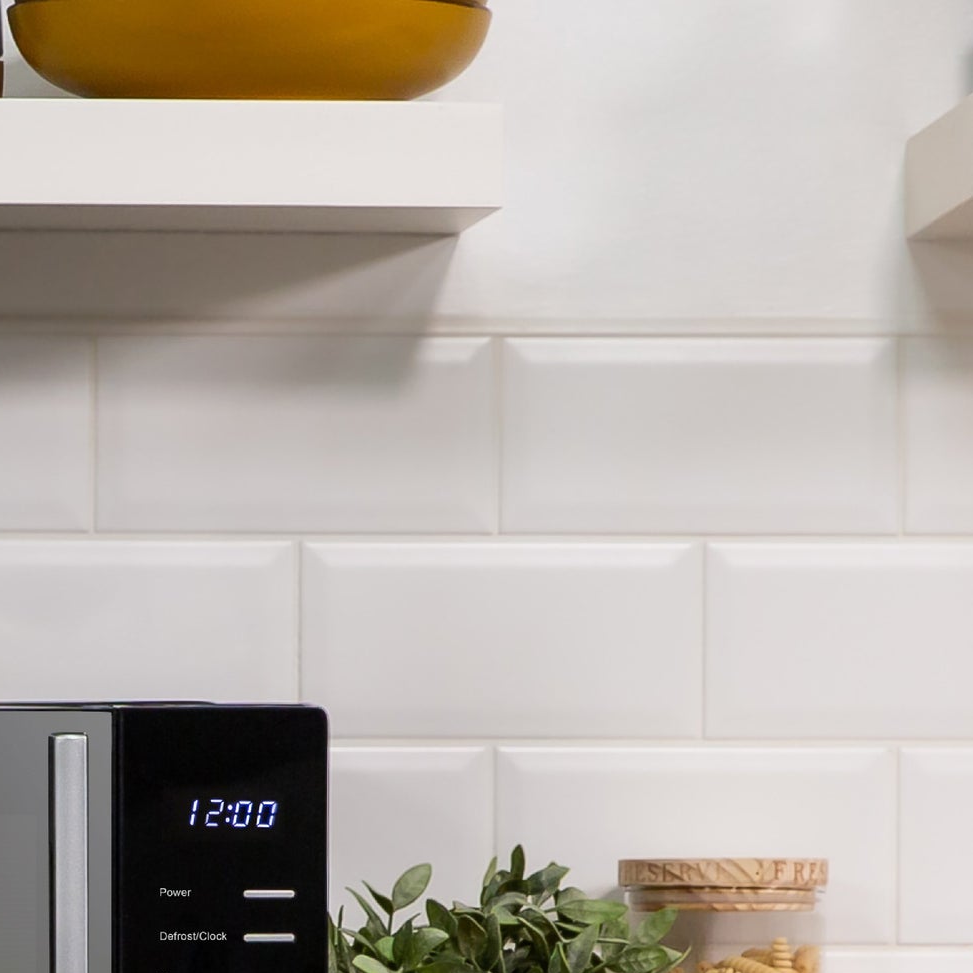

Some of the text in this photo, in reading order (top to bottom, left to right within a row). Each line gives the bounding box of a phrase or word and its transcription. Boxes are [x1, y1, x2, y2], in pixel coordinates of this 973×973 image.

[189, 799, 278, 828] 12:00
[159, 887, 192, 897] Power
[159, 931, 228, 941] Defrost/Clock
